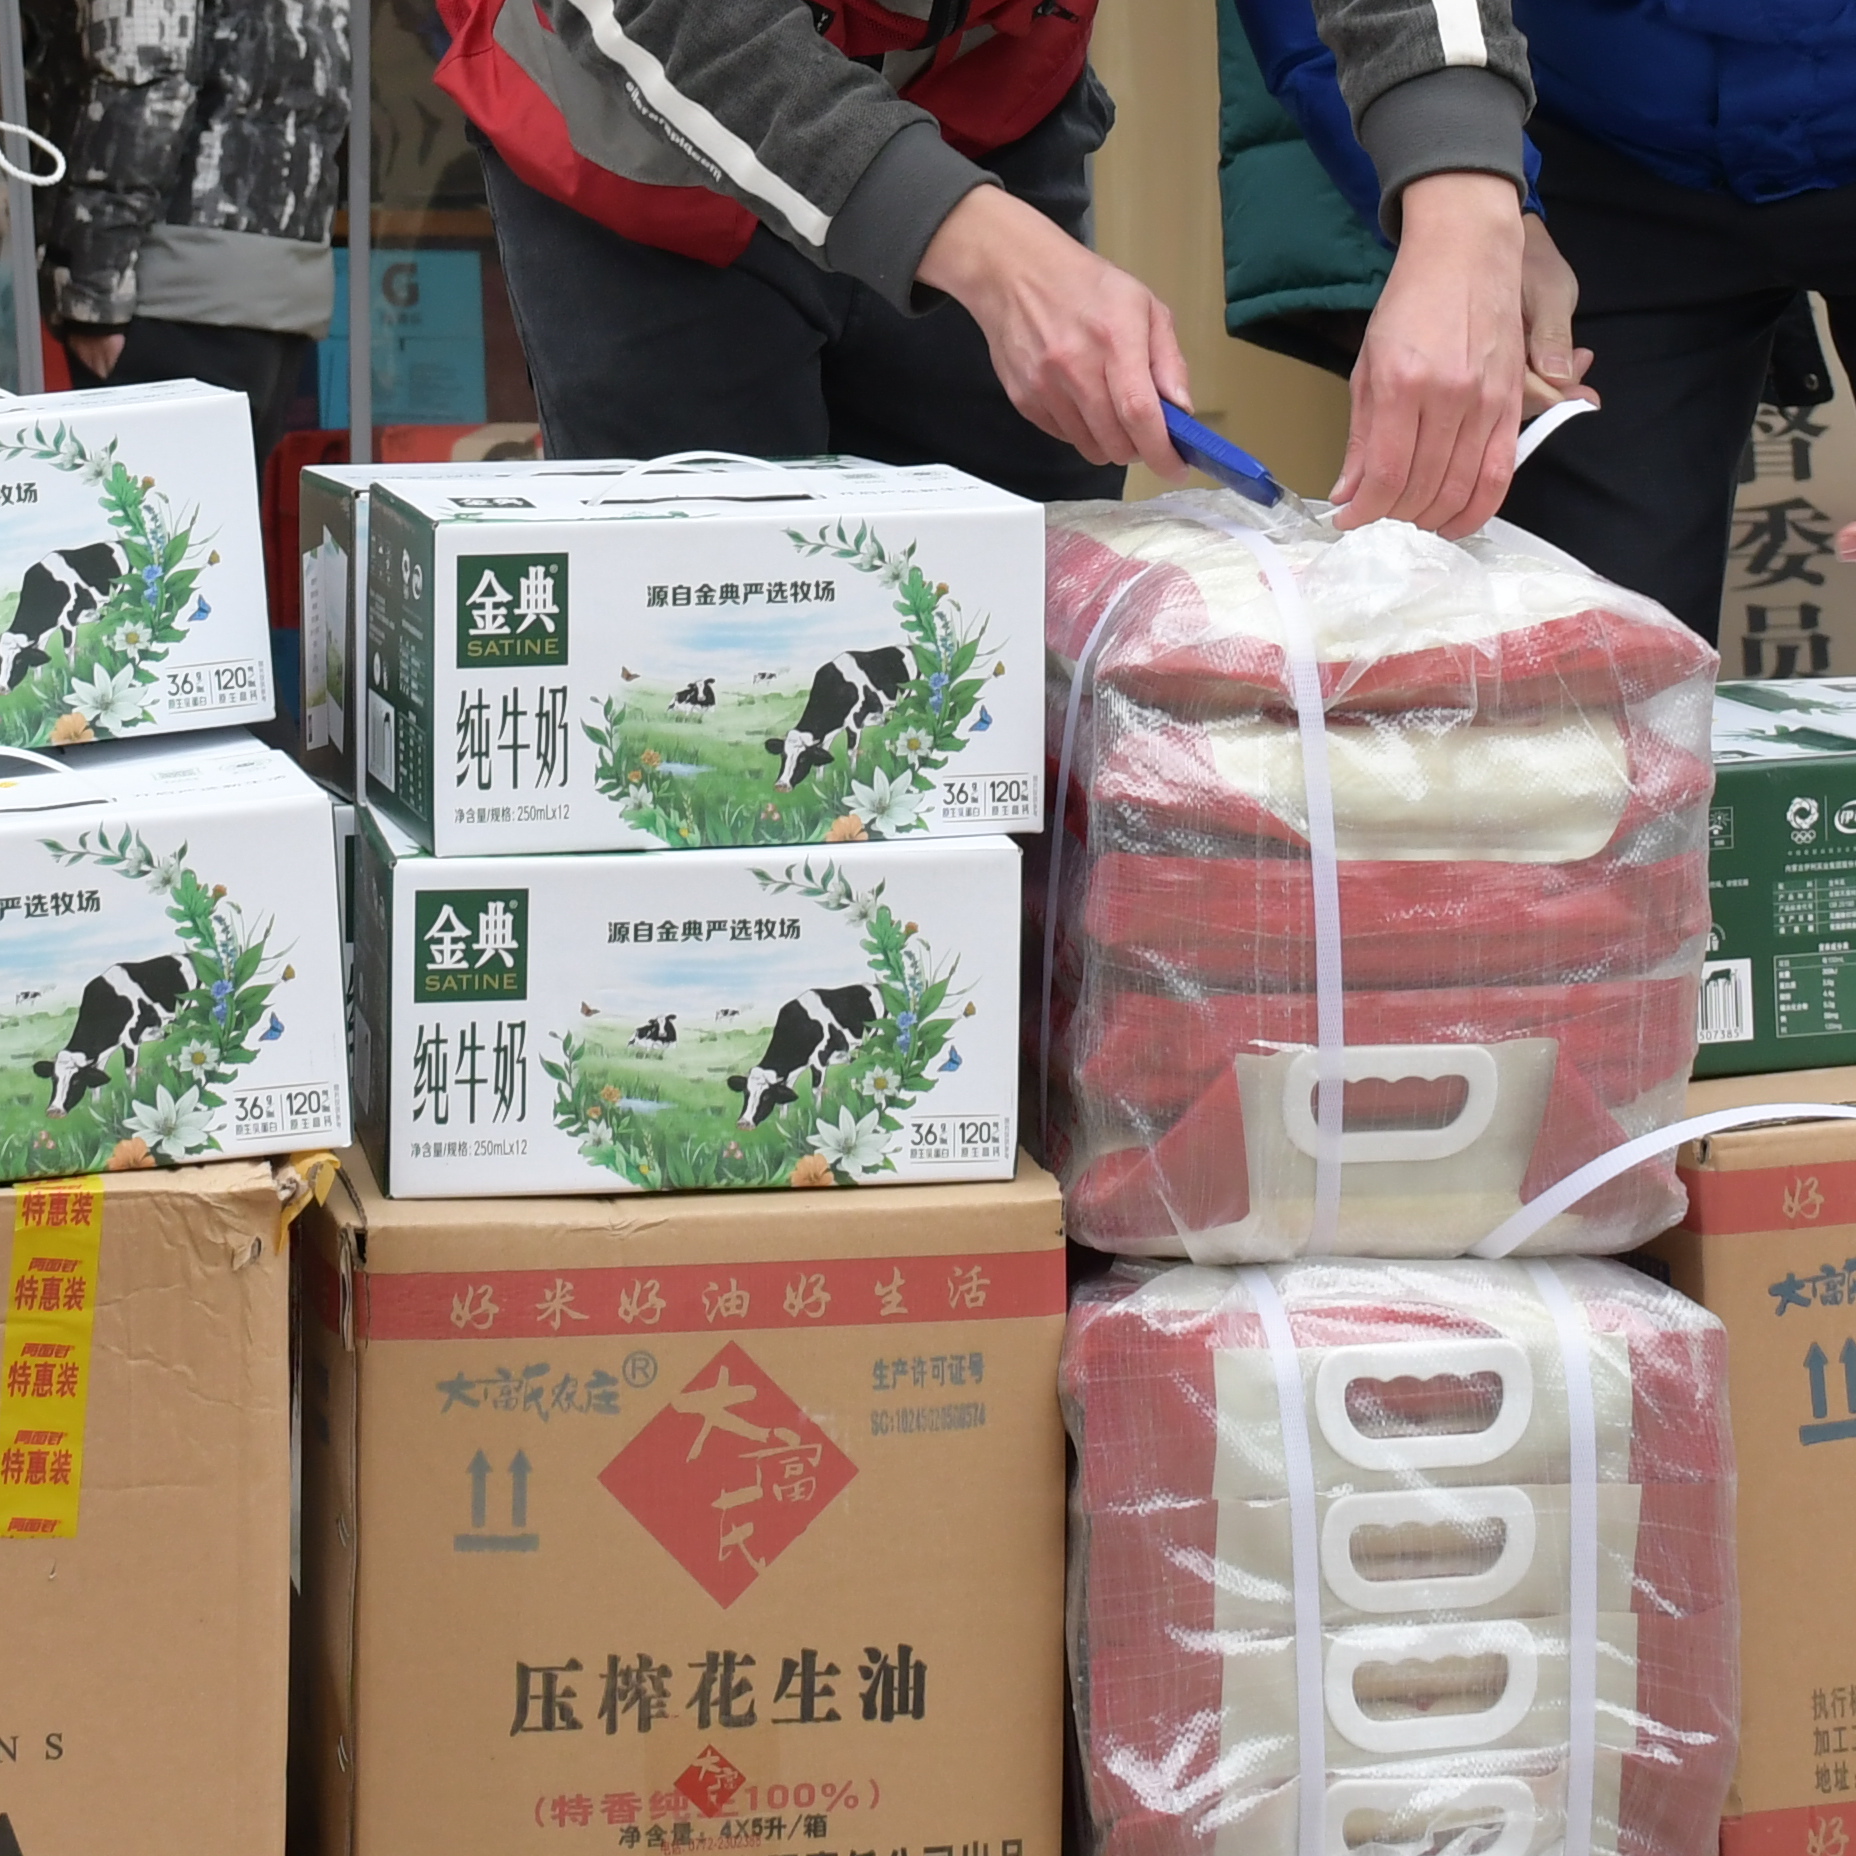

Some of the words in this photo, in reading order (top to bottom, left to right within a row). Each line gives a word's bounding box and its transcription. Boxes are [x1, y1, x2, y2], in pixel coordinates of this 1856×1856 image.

[464, 563, 560, 636] 金典
[646, 578, 837, 609] 源自金典严选牧场
[466, 637, 561, 659] SATINE
[454, 684, 570, 792] 纯牛奶
[423, 900, 519, 971] 金典
[606, 919, 802, 944] 源自金典严选牧场
[425, 972, 519, 993] SATINE
[411, 1018, 528, 1125] 纯牛奶
[21, 1188, 95, 1228] 特惠装
[14, 1275, 87, 1312] 特惠装
[448, 1264, 993, 1330] 好米好油好生活
[7, 1360, 81, 1399] 特惠装
[872, 1351, 985, 1391] 生产许可证号
[1, 1448, 74, 1486] 特惠装
[510, 1644, 928, 1737] 压榨花生油
